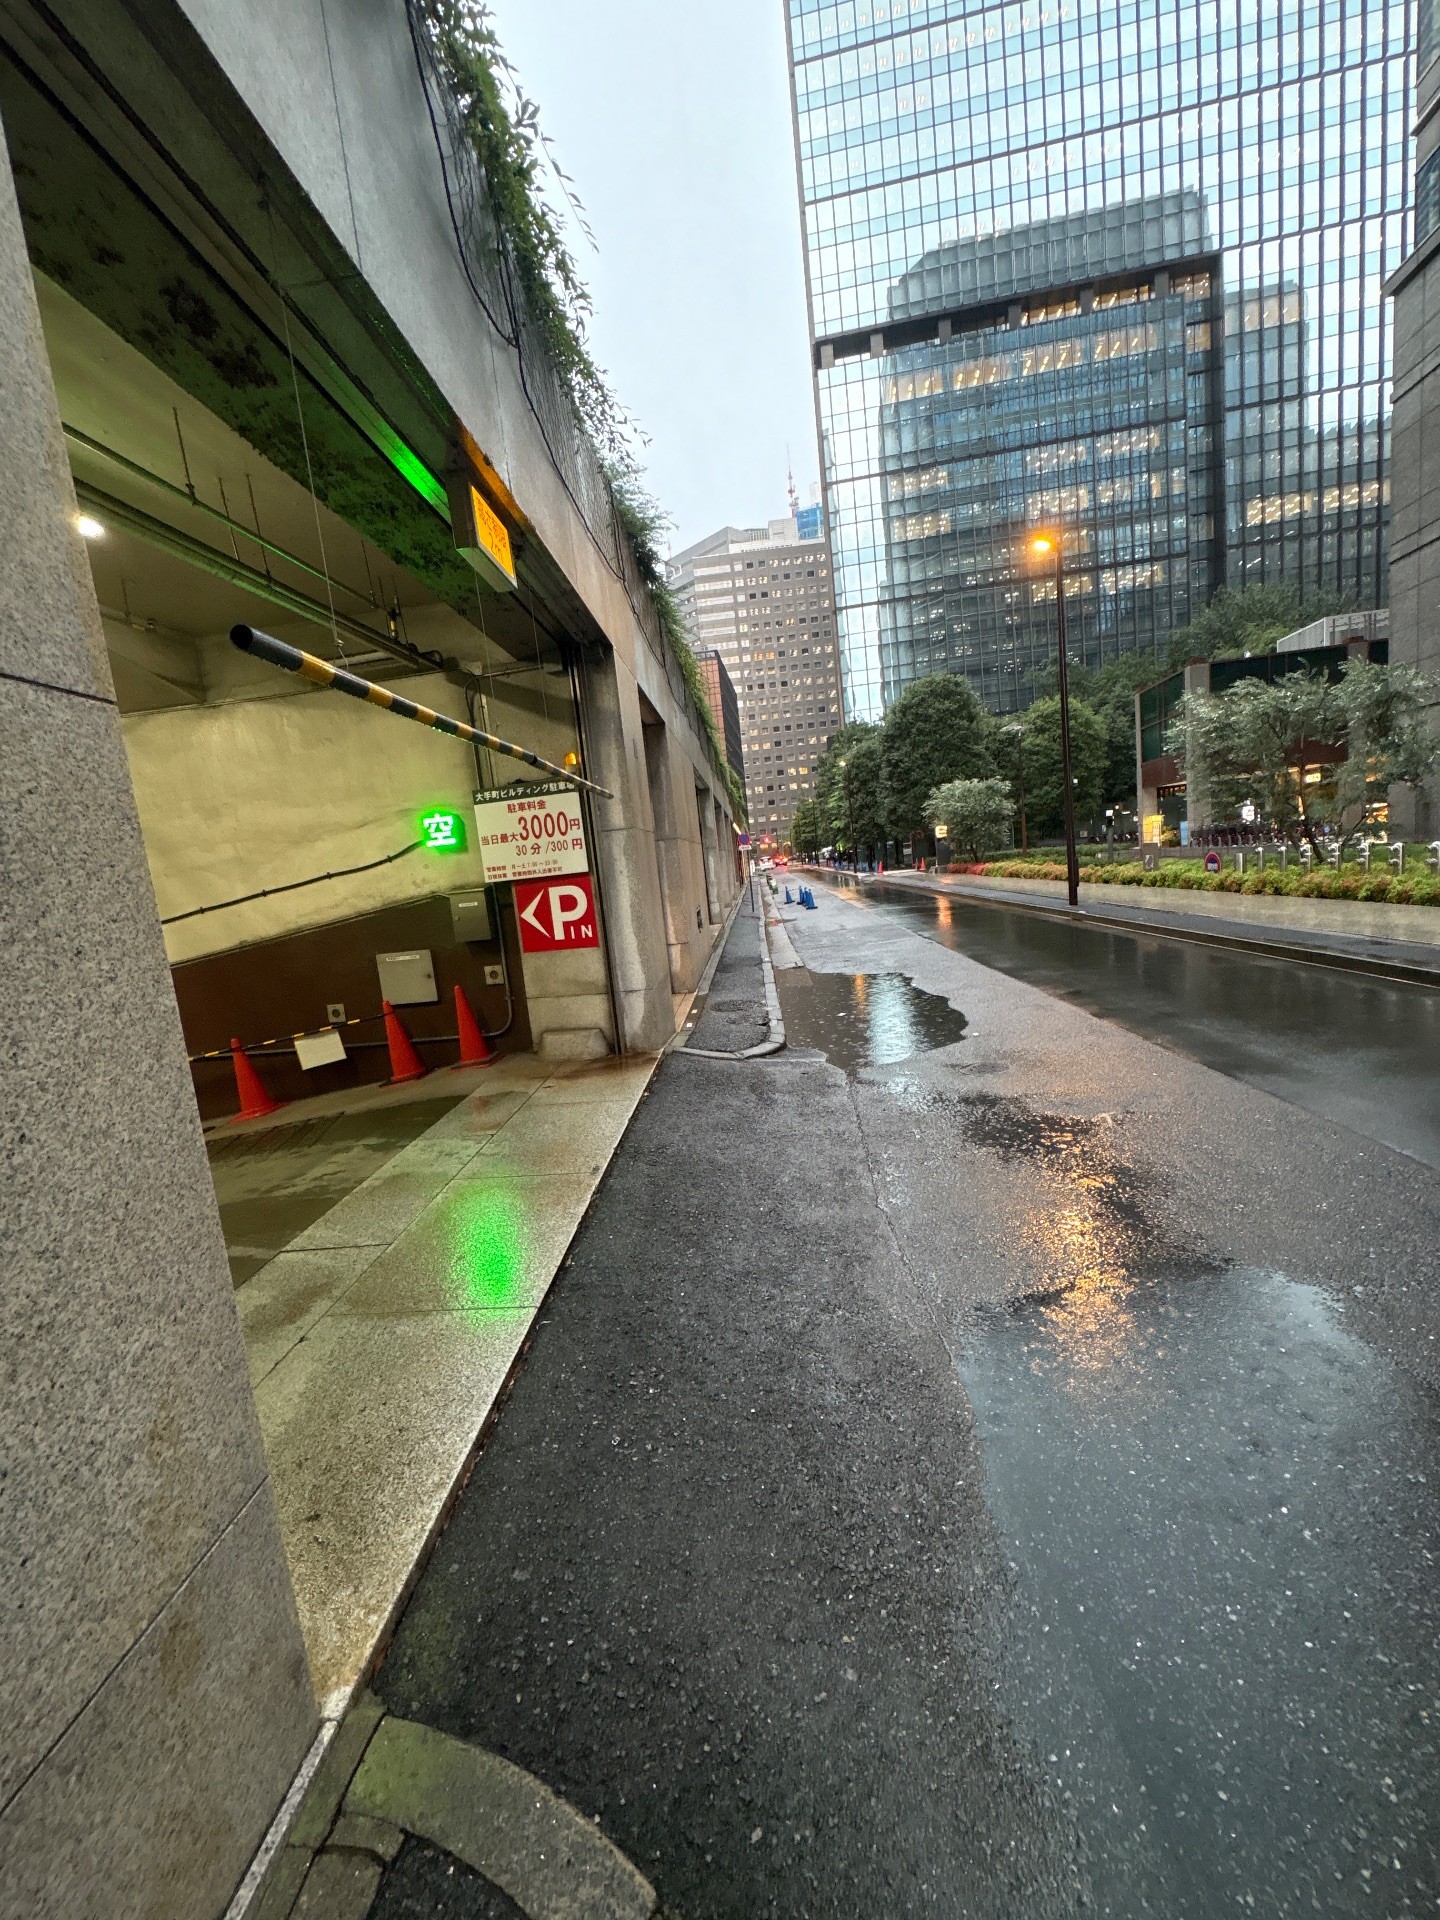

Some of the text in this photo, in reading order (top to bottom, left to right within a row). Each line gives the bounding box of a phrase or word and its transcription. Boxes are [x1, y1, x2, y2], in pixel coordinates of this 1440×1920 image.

[507, 800, 546, 813] 駐車料金
[423, 813, 457, 847] 空
[548, 885, 588, 941] P
[570, 924, 593, 939] IN
